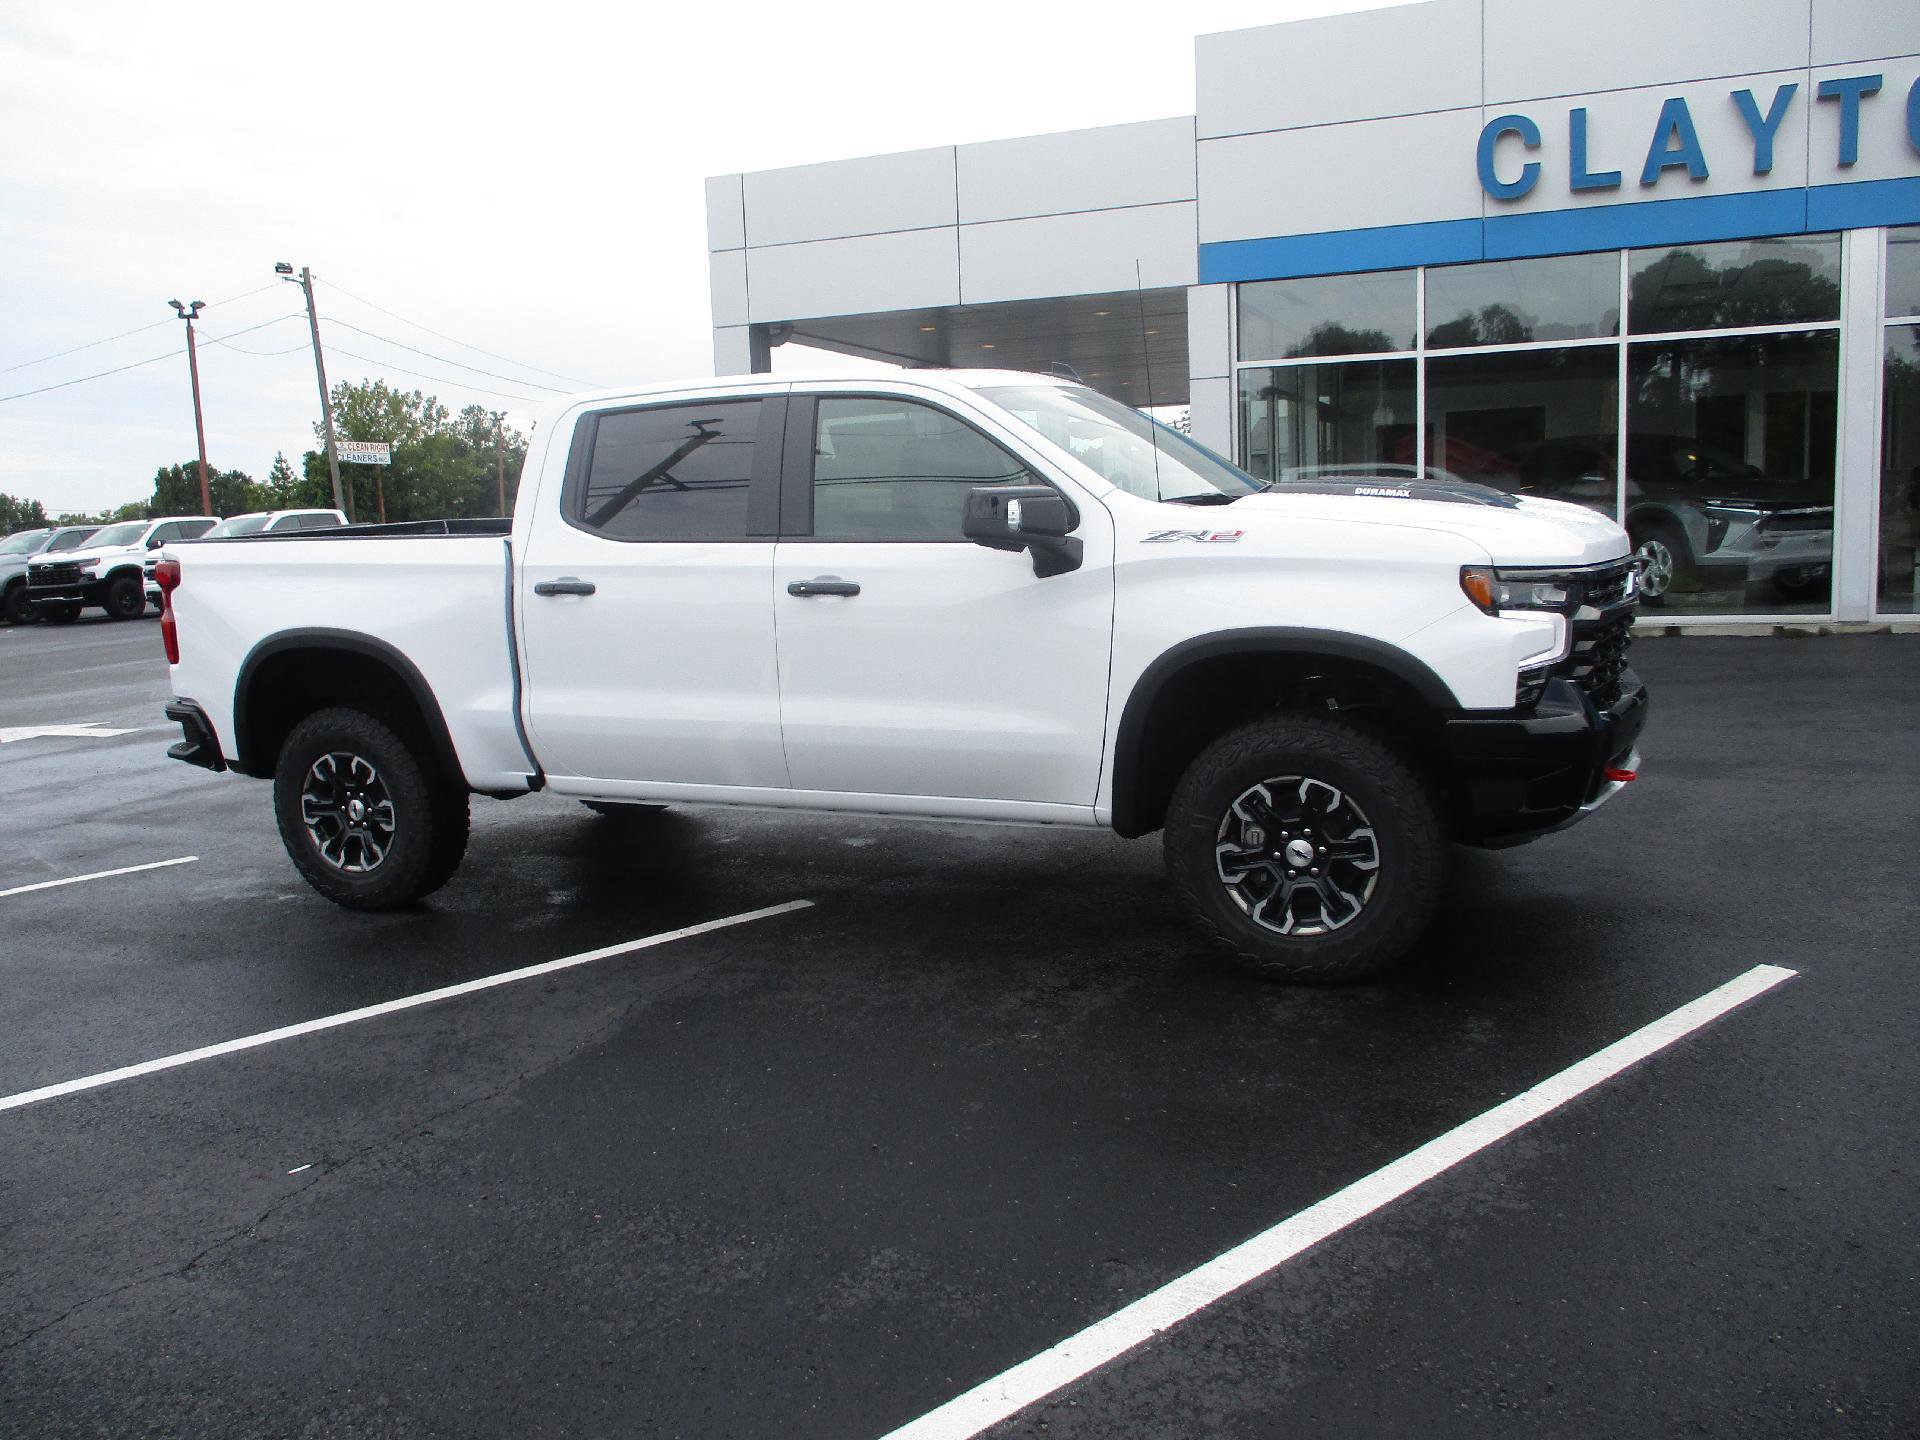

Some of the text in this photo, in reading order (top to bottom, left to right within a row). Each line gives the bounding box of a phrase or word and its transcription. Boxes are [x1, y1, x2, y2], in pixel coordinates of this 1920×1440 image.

[347, 442, 388, 453] CLEAN RIGHT
[336, 453, 378, 463] CLEANERS
[1354, 487, 1412, 498] DURAMAX
[1139, 530, 1246, 542] ZR2
